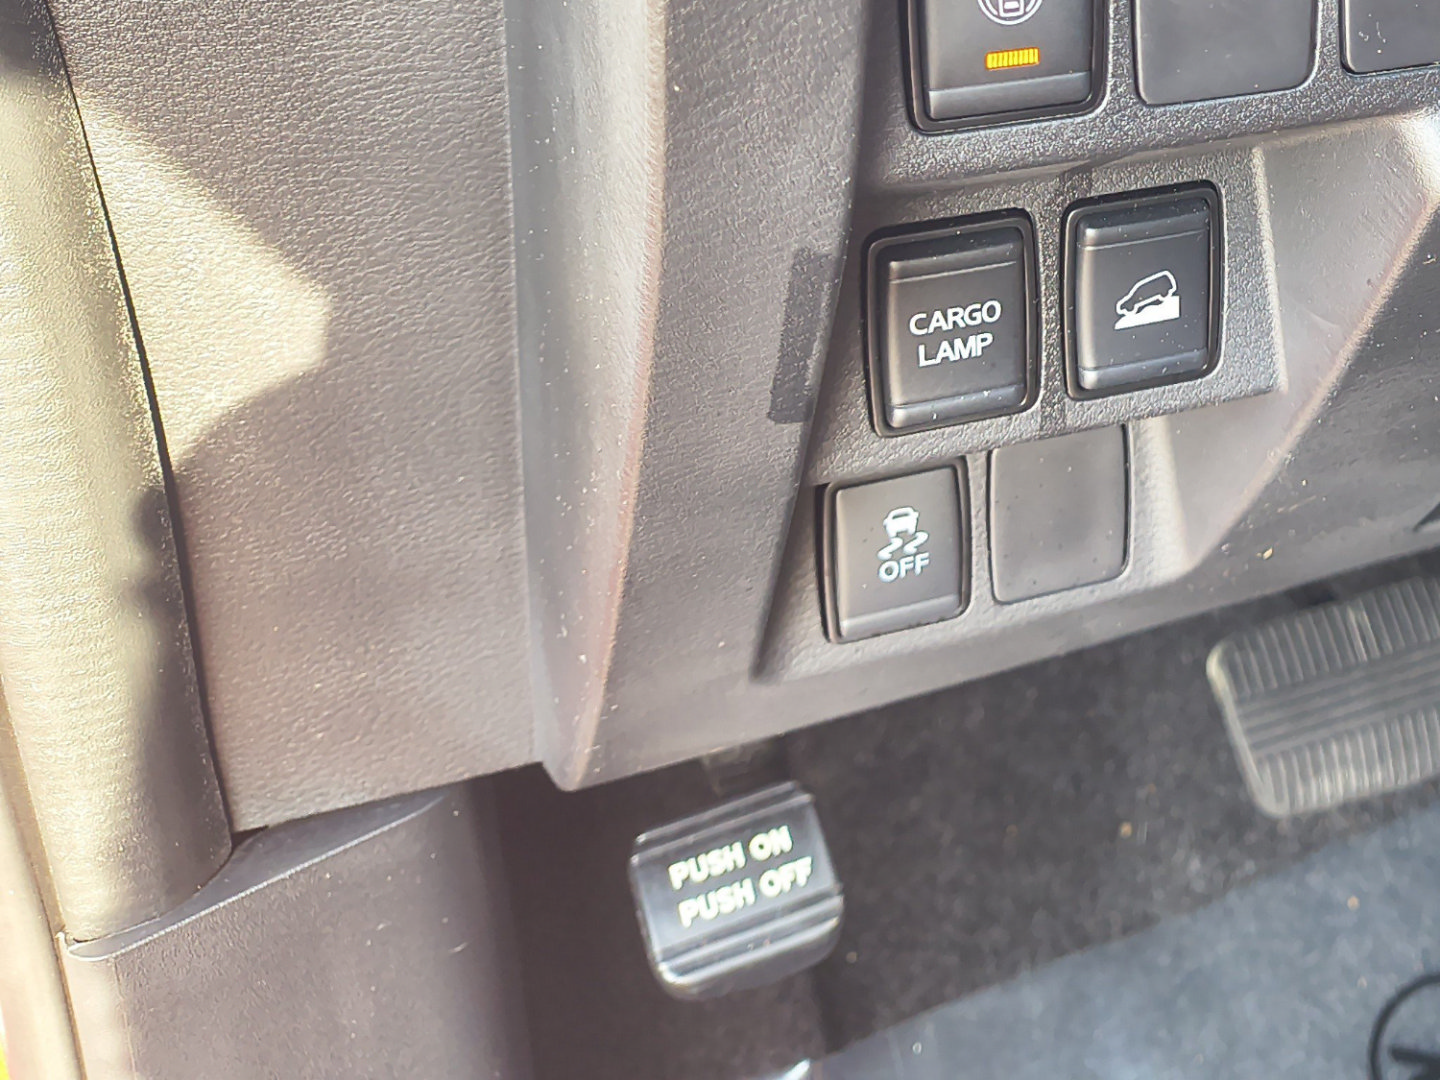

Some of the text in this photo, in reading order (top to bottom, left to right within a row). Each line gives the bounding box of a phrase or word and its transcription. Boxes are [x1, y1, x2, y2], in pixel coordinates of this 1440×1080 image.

[909, 299, 1001, 336] CARGO
[918, 332, 994, 367] LAMP
[878, 552, 930, 582] OFF
[668, 824, 793, 890] PUSH ON
[678, 855, 813, 928] PUSH OFF
